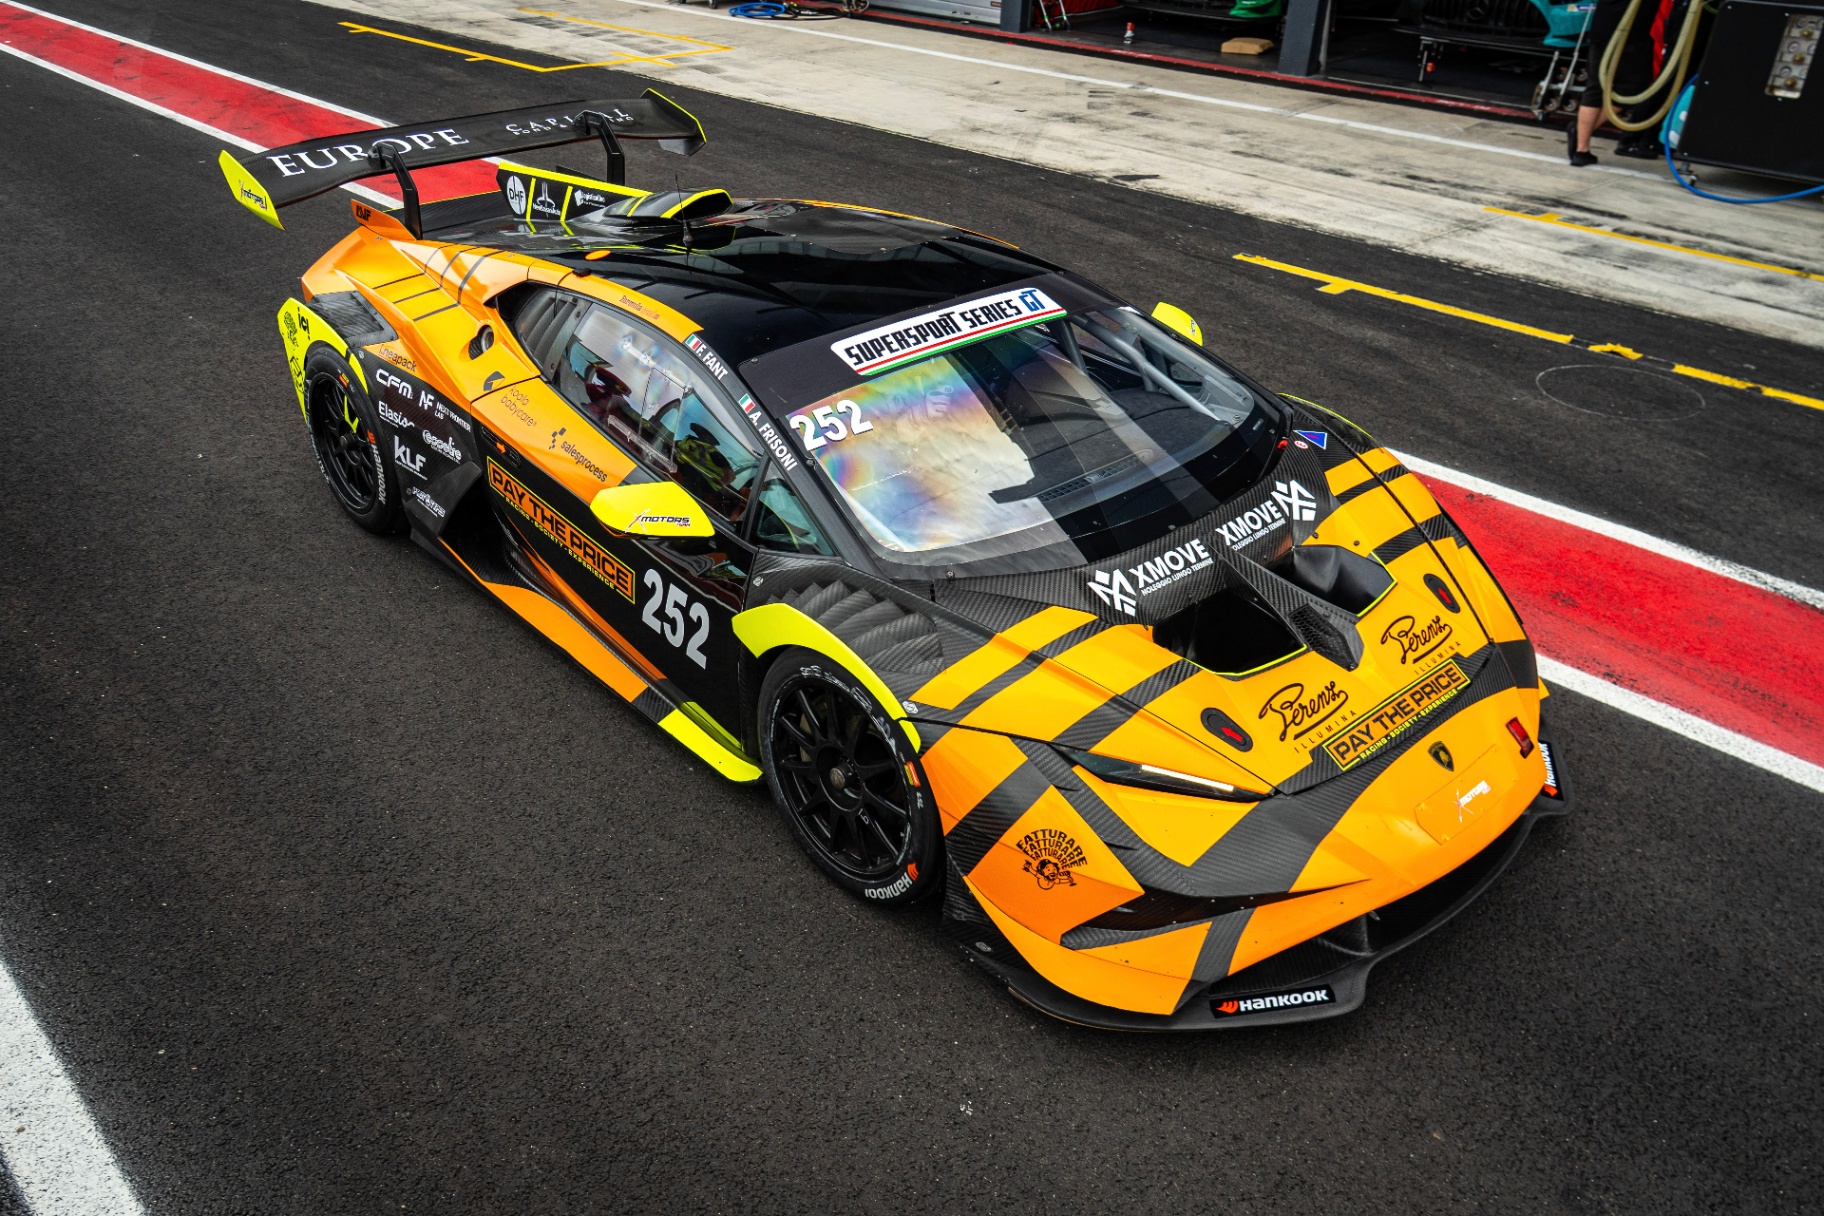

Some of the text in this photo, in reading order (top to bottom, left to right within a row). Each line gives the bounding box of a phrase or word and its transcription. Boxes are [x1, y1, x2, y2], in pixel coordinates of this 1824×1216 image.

[266, 129, 470, 178] EUROPE
[844, 289, 1045, 366] SUPERSPORT SERIES GT
[695, 341, 728, 380] F. FANT
[508, 384, 530, 406] koala
[748, 411, 798, 471] A. FRISONI
[788, 399, 875, 452] 252
[394, 434, 426, 472] KLF
[560, 441, 608, 483] salesprocess
[492, 467, 526, 506] PAY
[529, 497, 567, 542] THE
[569, 529, 629, 593] PRICE
[1215, 500, 1282, 546] XMOVE
[568, 548, 615, 590] EXPERIENCE
[1128, 538, 1210, 588] XMOVE
[1141, 557, 1214, 596] NOLEGGIO LUNGO TERMINE
[641, 568, 710, 670] 252
[1414, 641, 1461, 675] ILLUMINA
[1293, 710, 1357, 753] ILLUMINA
[1333, 667, 1462, 760] PAY THE PRICE
[1360, 688, 1458, 759] RACING SOCIETY EXPERIENCE
[1016, 829, 1088, 867] FATTURARE
[1023, 839, 1080, 868] FATTURARE
[1030, 847, 1071, 870] FATTURARE
